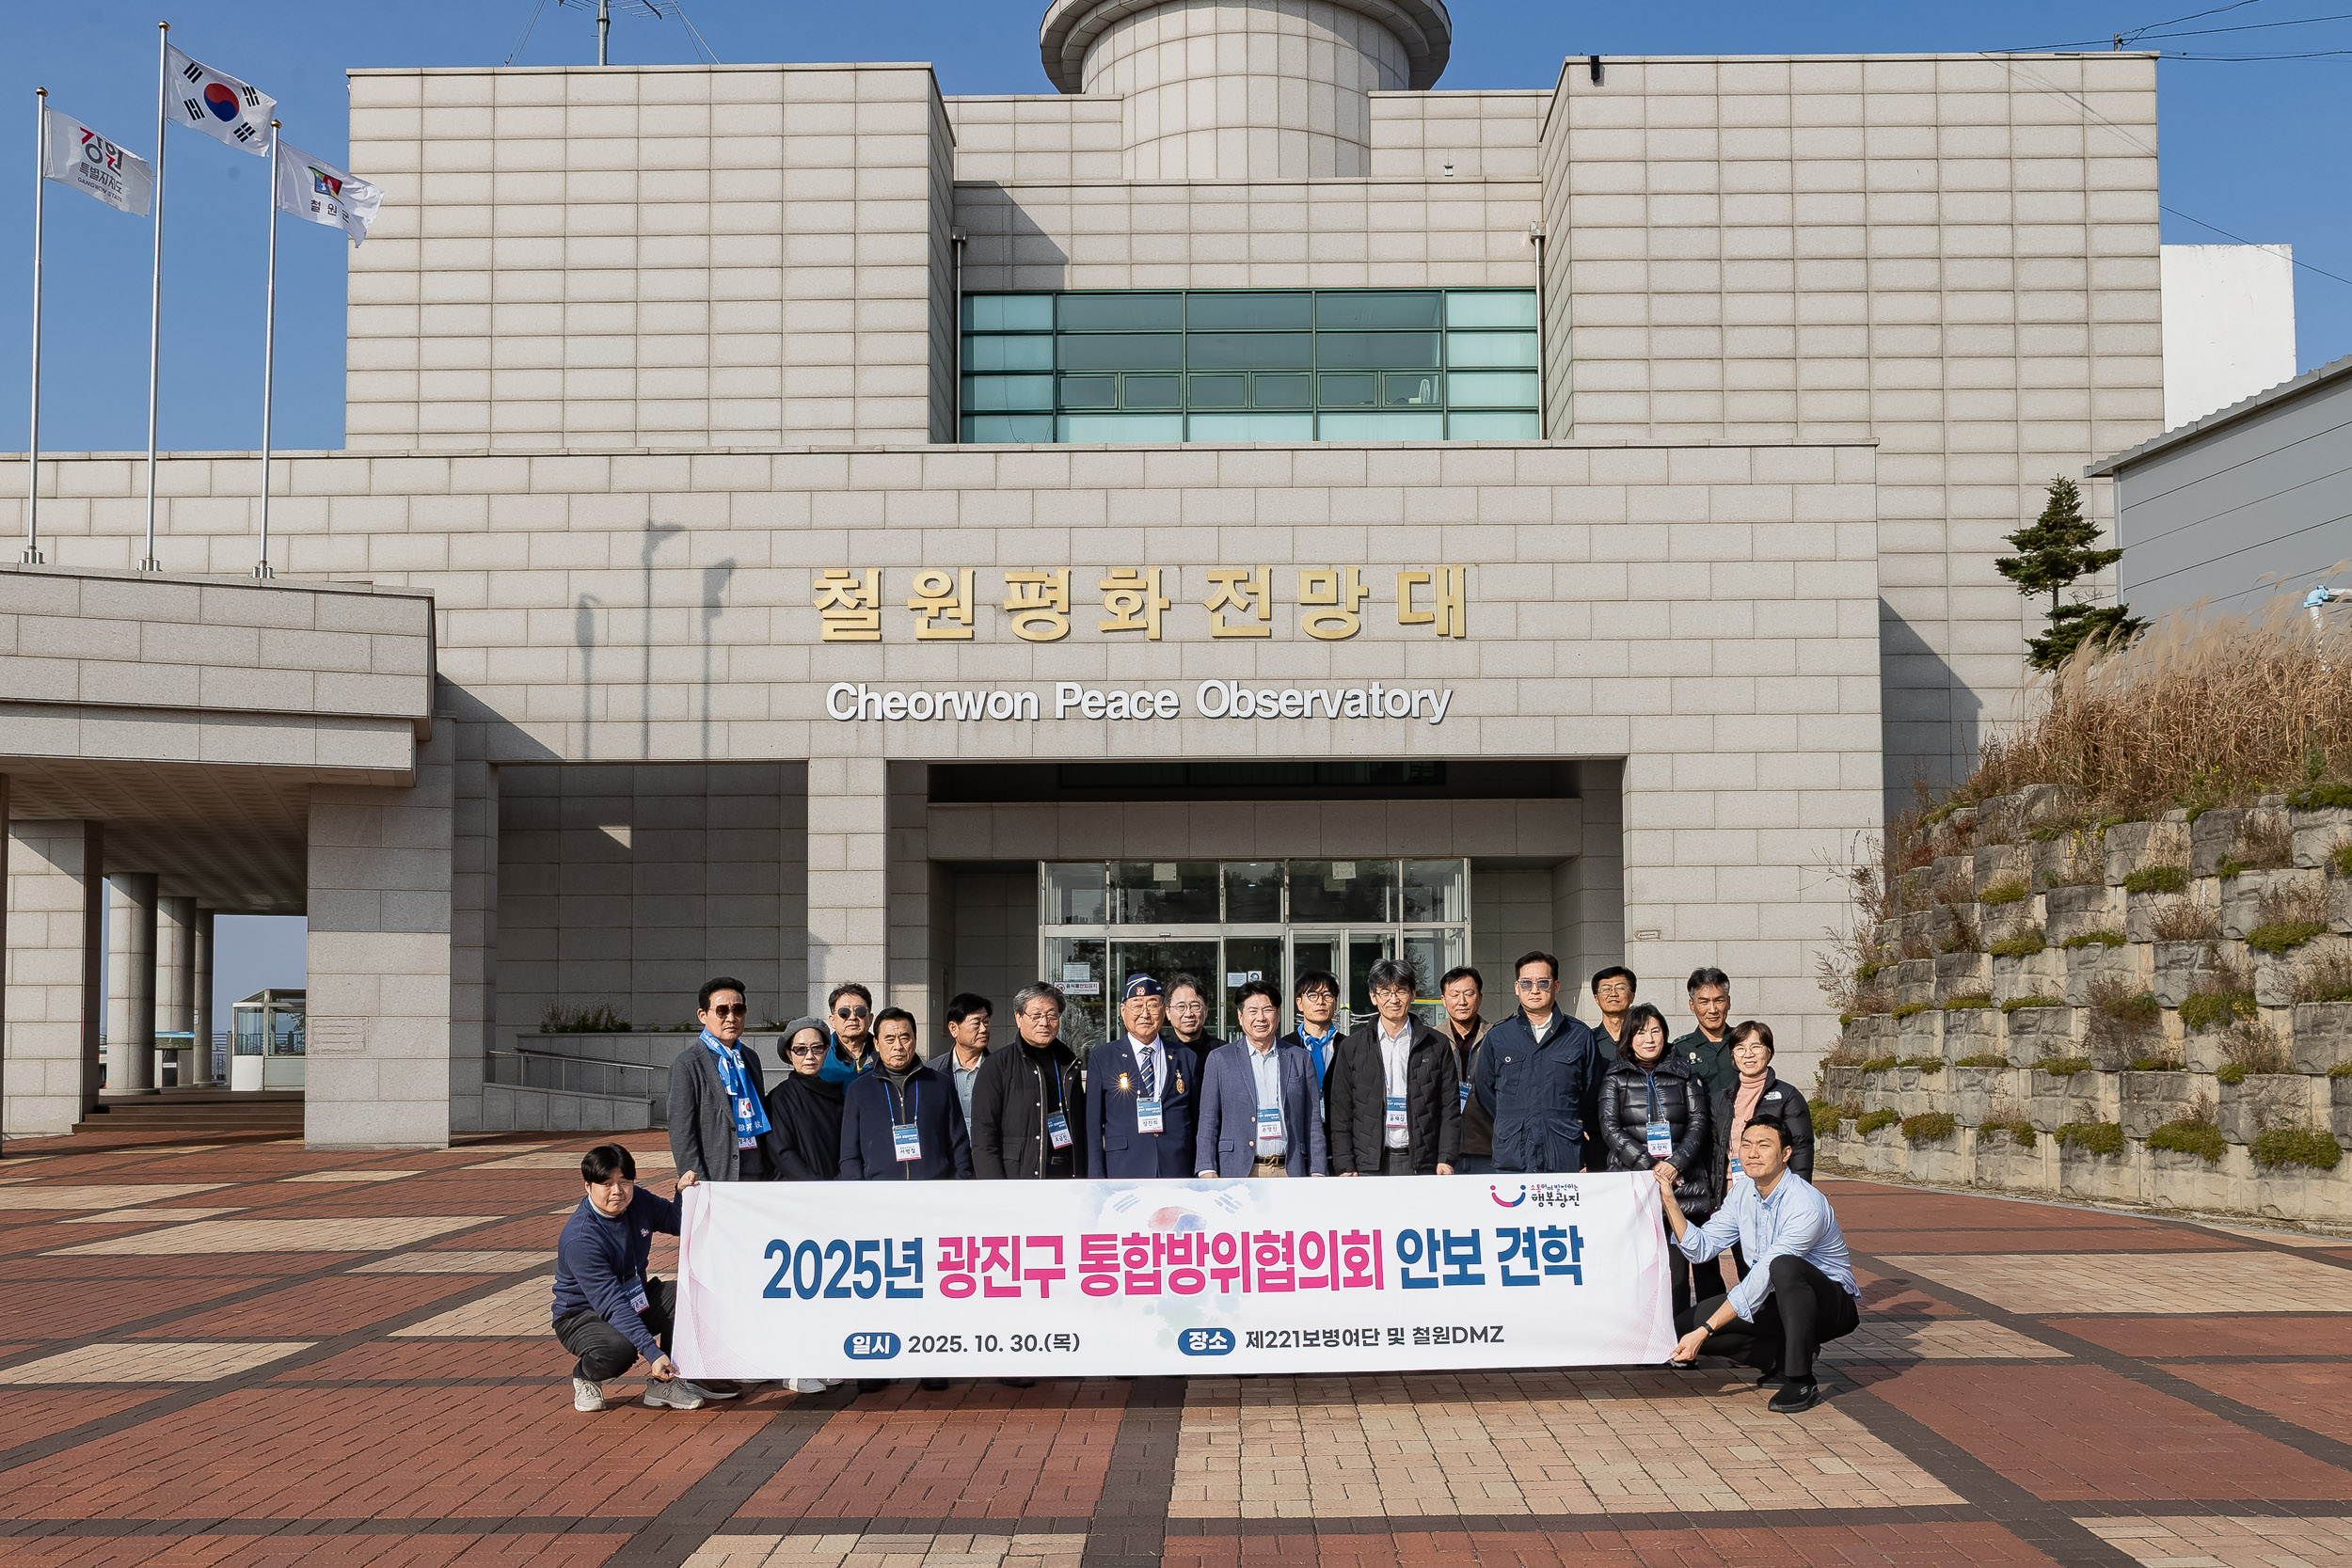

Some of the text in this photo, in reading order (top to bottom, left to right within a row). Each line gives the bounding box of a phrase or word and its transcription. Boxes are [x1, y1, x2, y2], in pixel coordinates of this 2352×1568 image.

[79, 126, 124, 178] 강원
[79, 161, 123, 195] 특별자치도
[813, 564, 1467, 641] 철원평화전망대
[825, 679, 1454, 725] Cheorwon Peace Observatory
[1531, 1191, 1581, 1209] 행복광진
[763, 1225, 1585, 1300] 2025년 광진구 통합방위협의회 안보 견학
[851, 1332, 1080, 1355] 일시 2025. 10. 30.(목)
[1188, 1324, 1505, 1352] 장소 제221보병여단 및 철원DMZ
